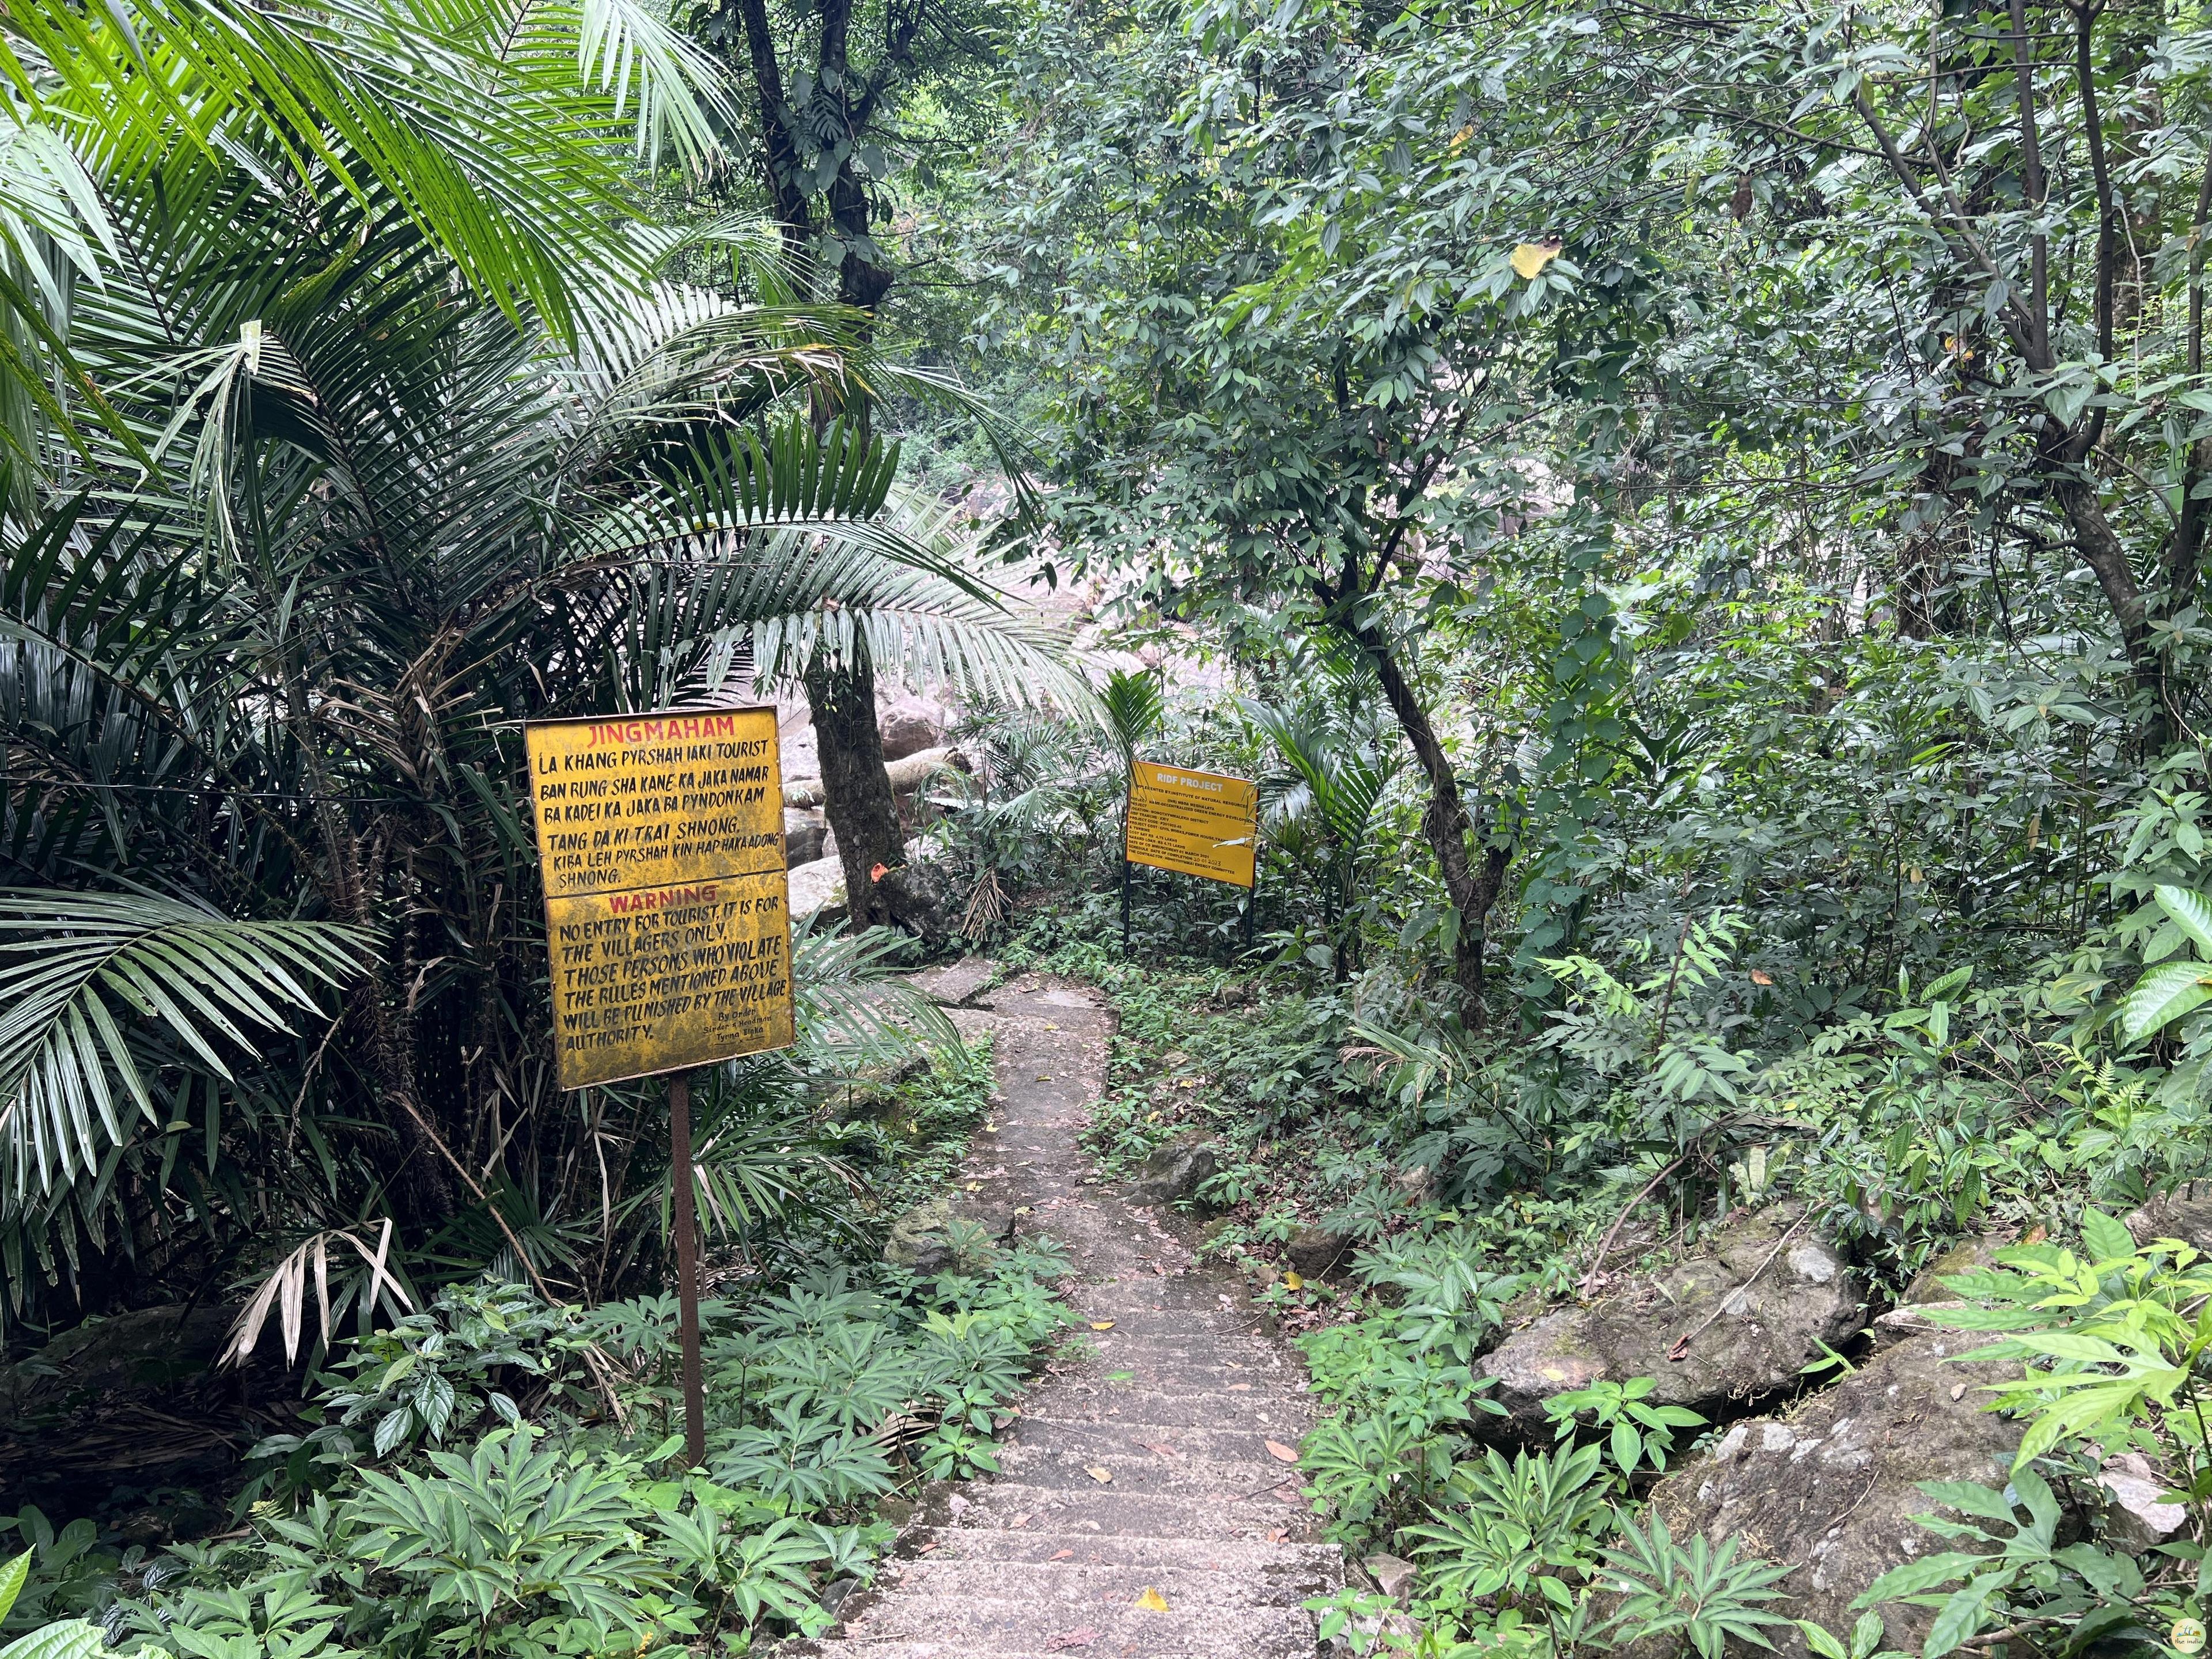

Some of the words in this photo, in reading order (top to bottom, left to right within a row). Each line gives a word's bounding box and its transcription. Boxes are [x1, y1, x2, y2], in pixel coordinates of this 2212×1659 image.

[587, 717, 734, 748] JINGMAHAM
[539, 752, 557, 774] LA
[565, 752, 617, 771] KHANG
[621, 747, 682, 767] PYRSHAH
[687, 744, 711, 760] IAKI
[716, 740, 768, 757] TOURIST
[541, 783, 566, 801] BAN
[571, 779, 607, 798] RUNG
[611, 777, 636, 795] SHA
[641, 774, 675, 792] KANE
[679, 772, 695, 789] KA
[698, 770, 727, 789] JAKA
[730, 766, 768, 784] NAMAR
[1157, 773, 1177, 784] RIDF
[1180, 777, 1222, 792] PROJECT
[544, 807, 560, 825] BA
[565, 804, 600, 821] KADEI
[605, 801, 621, 819] KA
[626, 798, 660, 817] JAKA
[664, 796, 677, 813] BA
[682, 787, 764, 810] PYNDONKAM
[548, 834, 587, 852] TANG
[593, 830, 609, 847] DA
[614, 828, 628, 845] KI
[635, 824, 669, 843] TRAI
[676, 816, 740, 839] SHNONG.
[554, 853, 581, 872] KIBA
[588, 850, 611, 867] LEH
[616, 846, 668, 865] PYRSHAH
[673, 842, 692, 858] KIN
[696, 840, 721, 856] HAP
[1211, 866, 1234, 874] COMMITTEE
[559, 869, 621, 888] SHNONG.
[609, 885, 719, 913] WARNING
[560, 926, 580, 941] NO
[584, 918, 630, 939] ENTRY
[635, 914, 658, 930] FOR
[663, 904, 719, 927] TOURIST,
[724, 901, 737, 918] IT
[740, 900, 750, 915] IS
[755, 896, 778, 912] FOR
[562, 944, 593, 964] THE
[601, 930, 681, 957] VILLAGERS
[685, 922, 726, 945] ONLY.
[564, 963, 617, 988] THOSE
[623, 950, 689, 979] PERSONS
[693, 946, 725, 968] WHO
[726, 935, 782, 960] VIOLATE
[565, 991, 593, 1010] THE
[599, 981, 645, 1005] RULES
[650, 968, 726, 994] MENTIONED
[730, 959, 778, 980] ABOVE
[563, 1014, 599, 1031] WILL
[604, 1008, 620, 1025] BE
[624, 997, 691, 1022] PUNISHED
[694, 993, 711, 1010] BY
[714, 988, 737, 1006] THE
[740, 979, 787, 1002] VILLAGE
[718, 1012, 729, 1021] By
[732, 1008, 756, 1018] Order
[739, 1016, 771, 1026] Headman
[566, 1024, 654, 1051] AUTHORITY.
